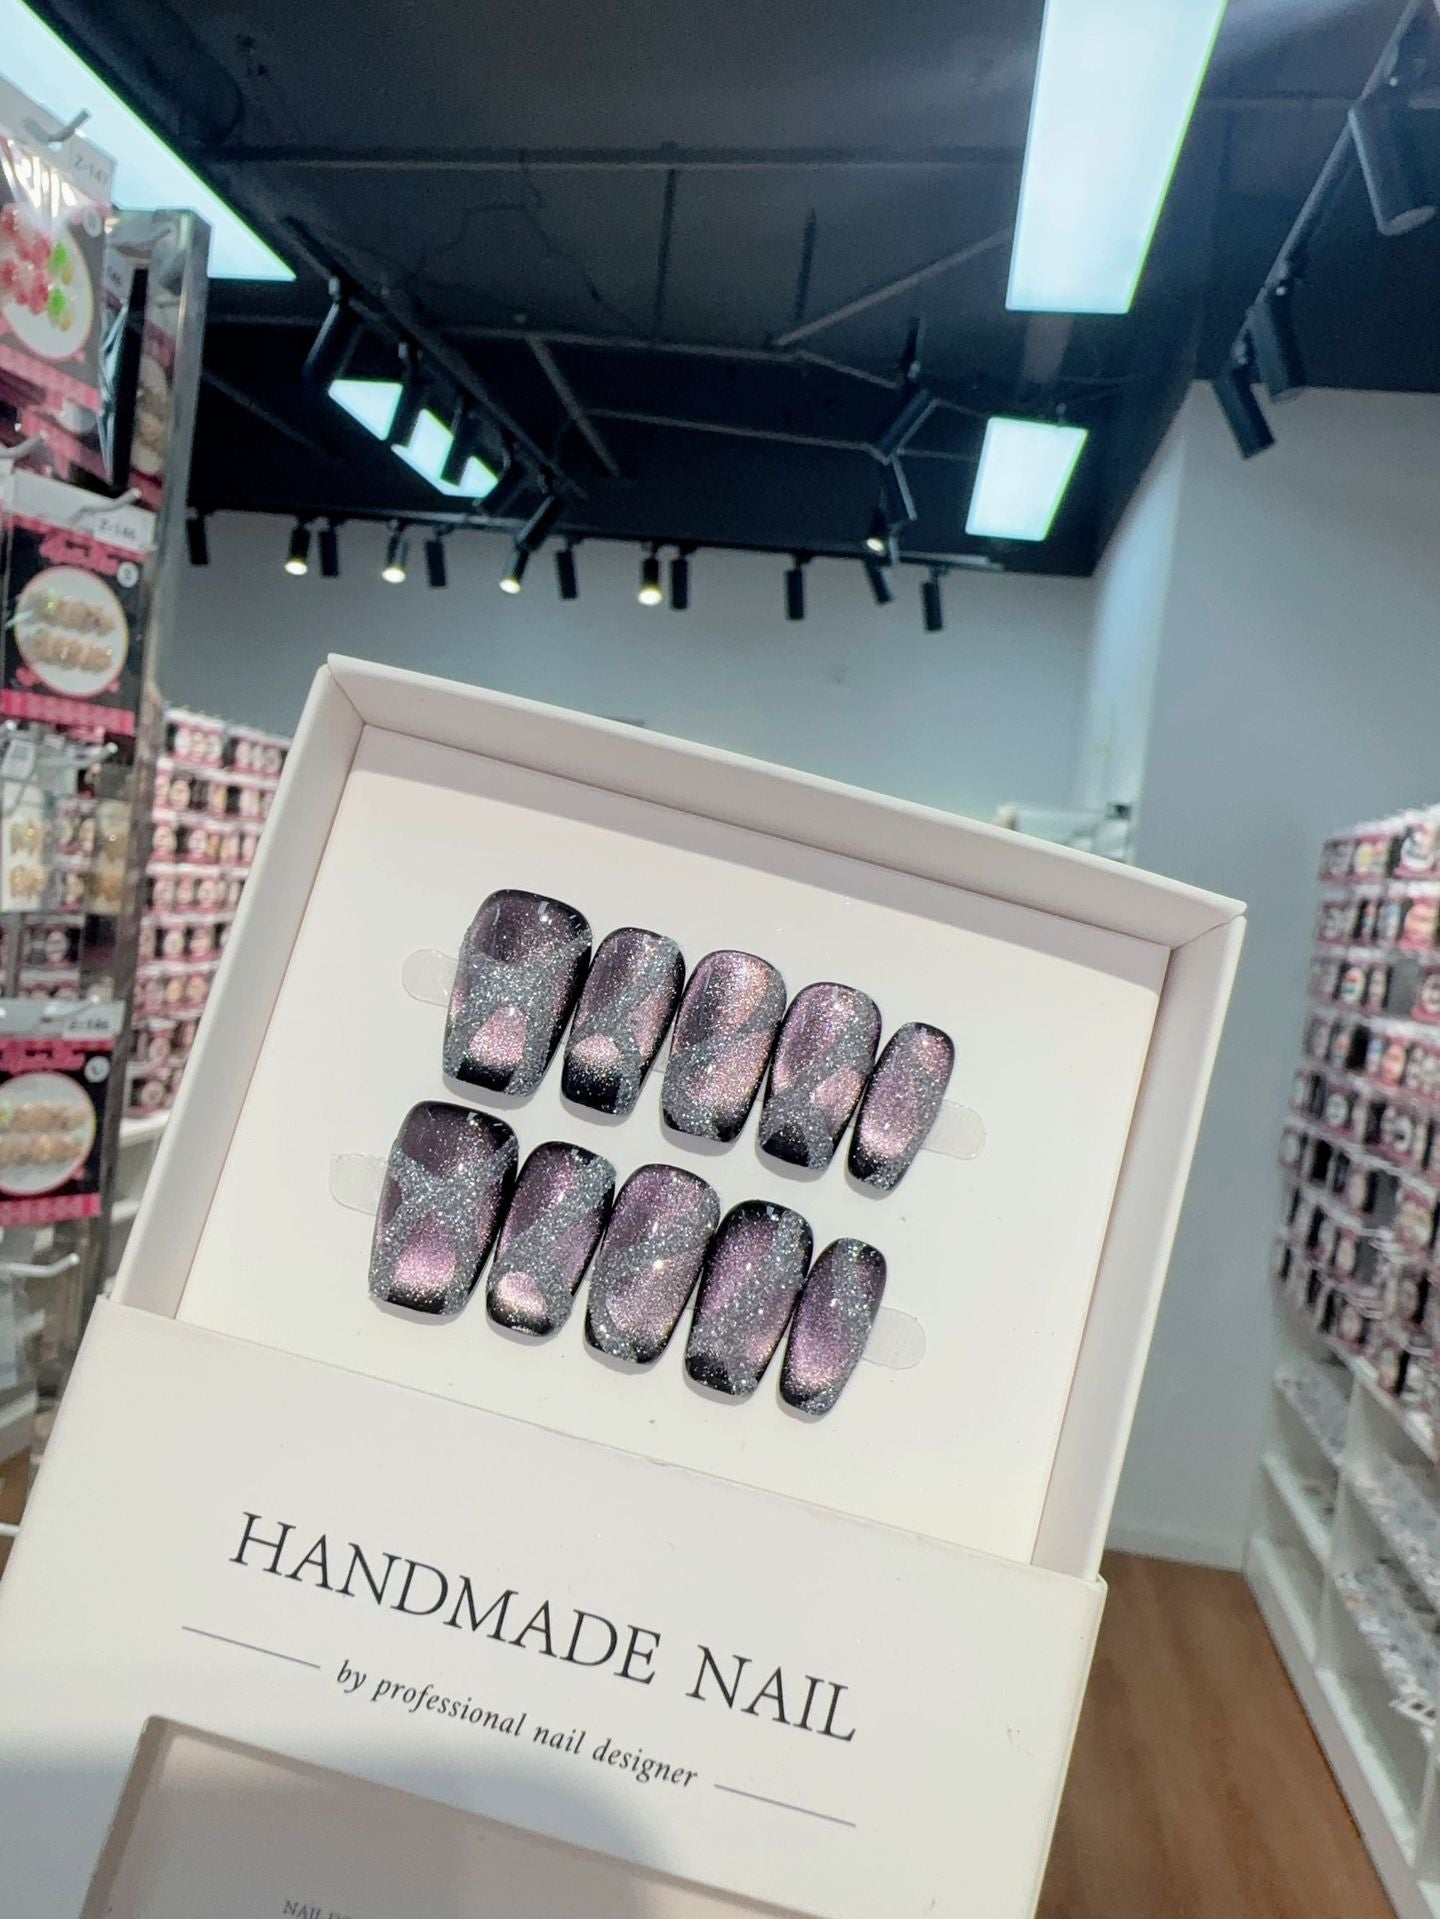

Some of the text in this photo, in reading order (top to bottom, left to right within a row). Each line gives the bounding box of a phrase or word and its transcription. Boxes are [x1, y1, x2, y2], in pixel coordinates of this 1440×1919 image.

[228, 1511, 856, 1743] HANDMADE NAIL
[336, 1658, 699, 1788] by professional nail designer
